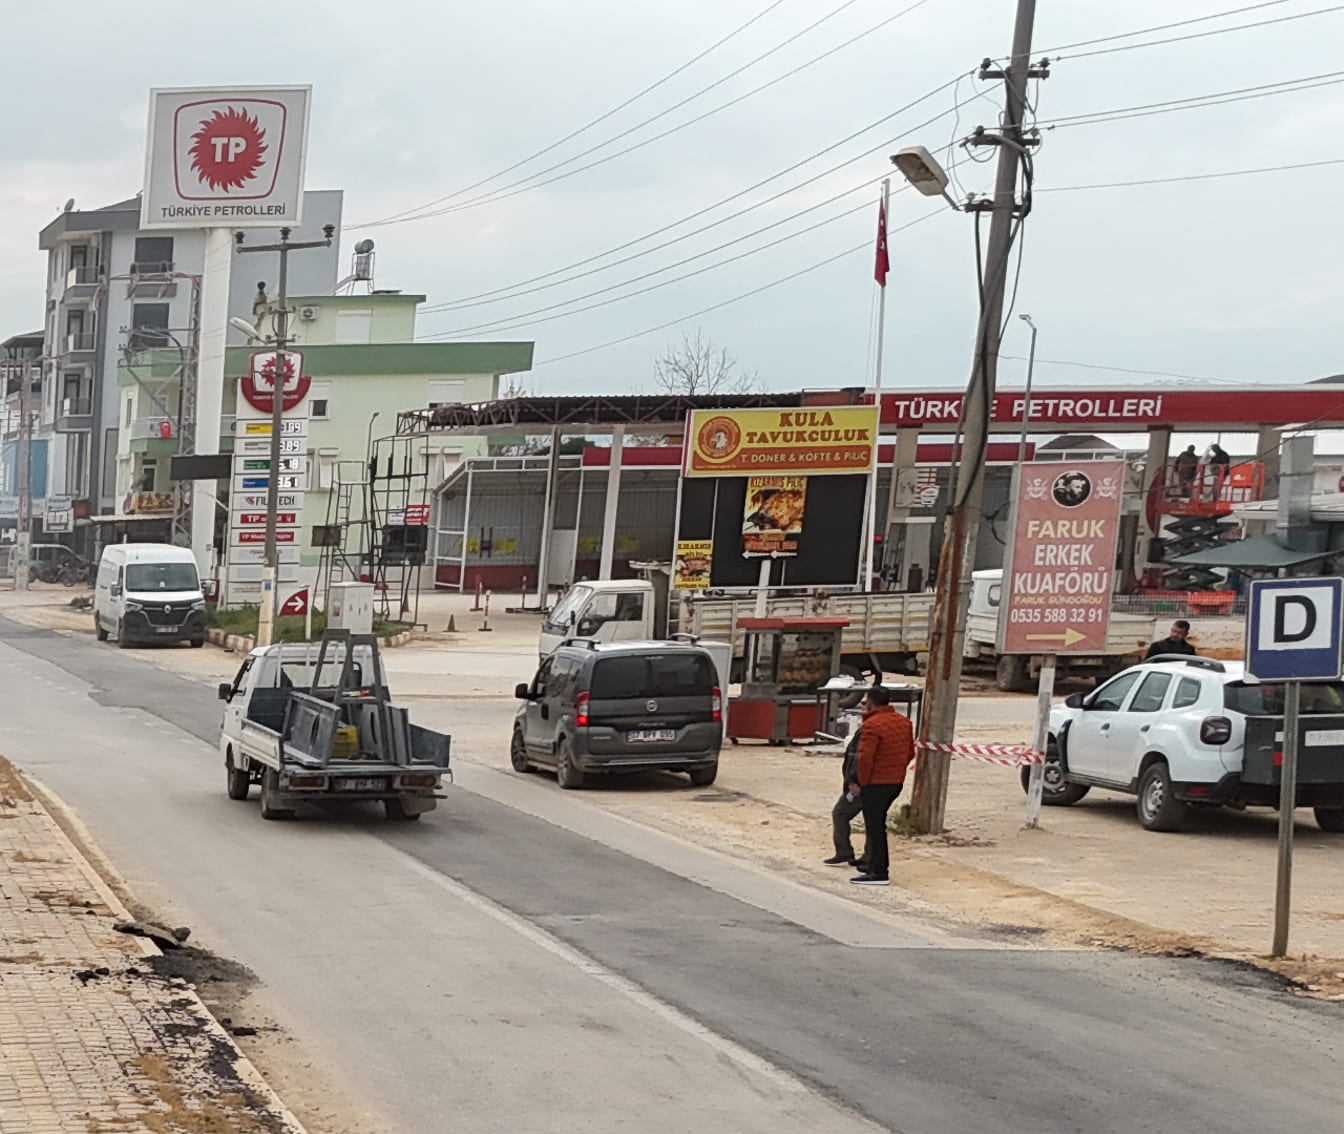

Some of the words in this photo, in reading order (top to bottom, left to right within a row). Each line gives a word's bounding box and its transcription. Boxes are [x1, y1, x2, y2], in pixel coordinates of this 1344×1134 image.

[210, 137, 247, 163] TP
[161, 204, 211, 218] TÜRKİYE
[214, 203, 286, 216] PETROLLERİ
[895, 397, 998, 419] TÜRKE
[1012, 395, 1162, 418] PETROLLERİ
[778, 411, 834, 428] KULA
[746, 429, 869, 444] TAVUKCULUK
[255, 496, 295, 506] FILECH
[1027, 520, 1106, 538] FARUK
[1034, 544, 1094, 566] ERKEK
[1014, 567, 1108, 594] KUAFÖRÜ
[1011, 608, 1041, 623] 0535
[1044, 608, 1067, 622] 588
[1070, 608, 1086, 622] 32
[1088, 608, 1103, 622] 91
[1273, 595, 1317, 643] D
